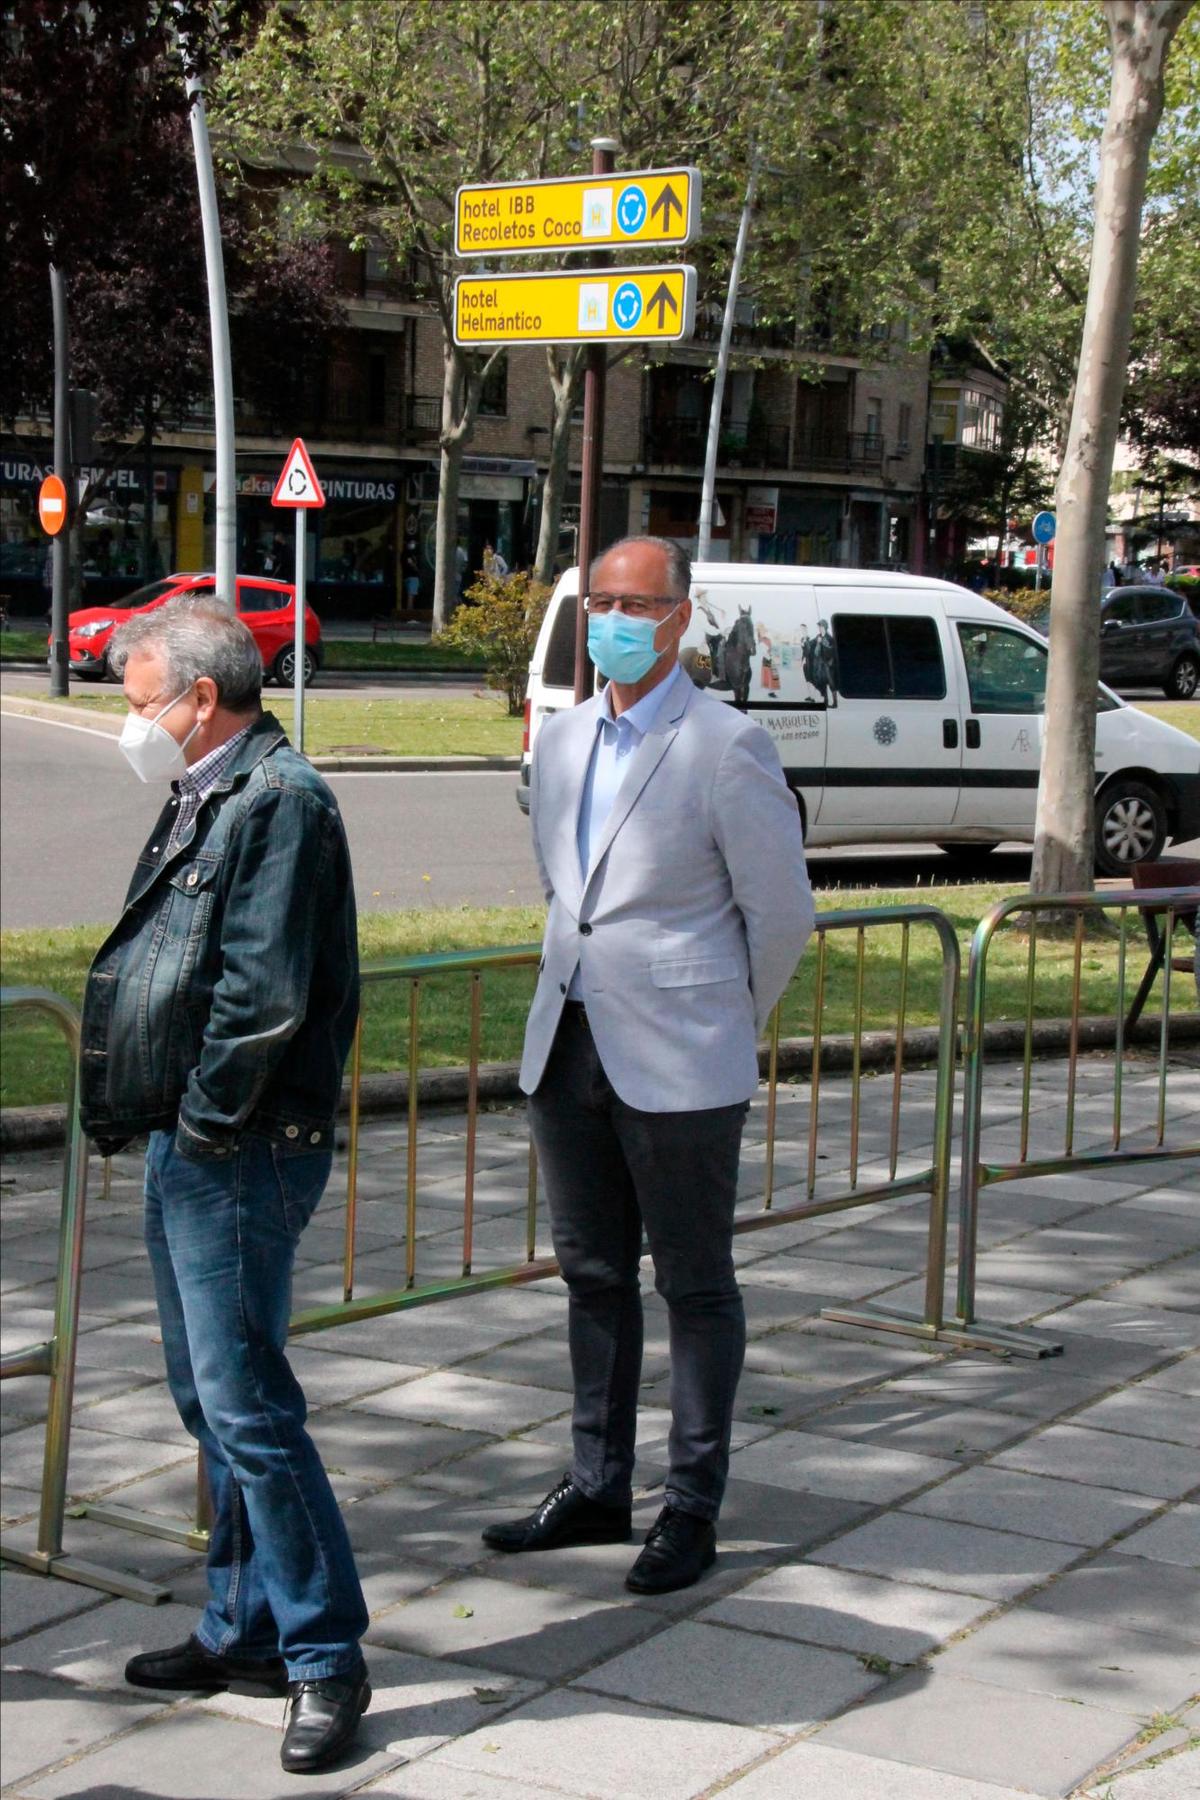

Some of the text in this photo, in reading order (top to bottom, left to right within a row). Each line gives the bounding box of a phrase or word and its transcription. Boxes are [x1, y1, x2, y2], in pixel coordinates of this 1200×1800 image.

[463, 195, 535, 218] hotel IBB
[463, 217, 581, 242] Recoletos Coco
[462, 289, 498, 308] hotel
[461, 311, 542, 332] Helmántico
[319, 480, 396, 501] PINTURAS
